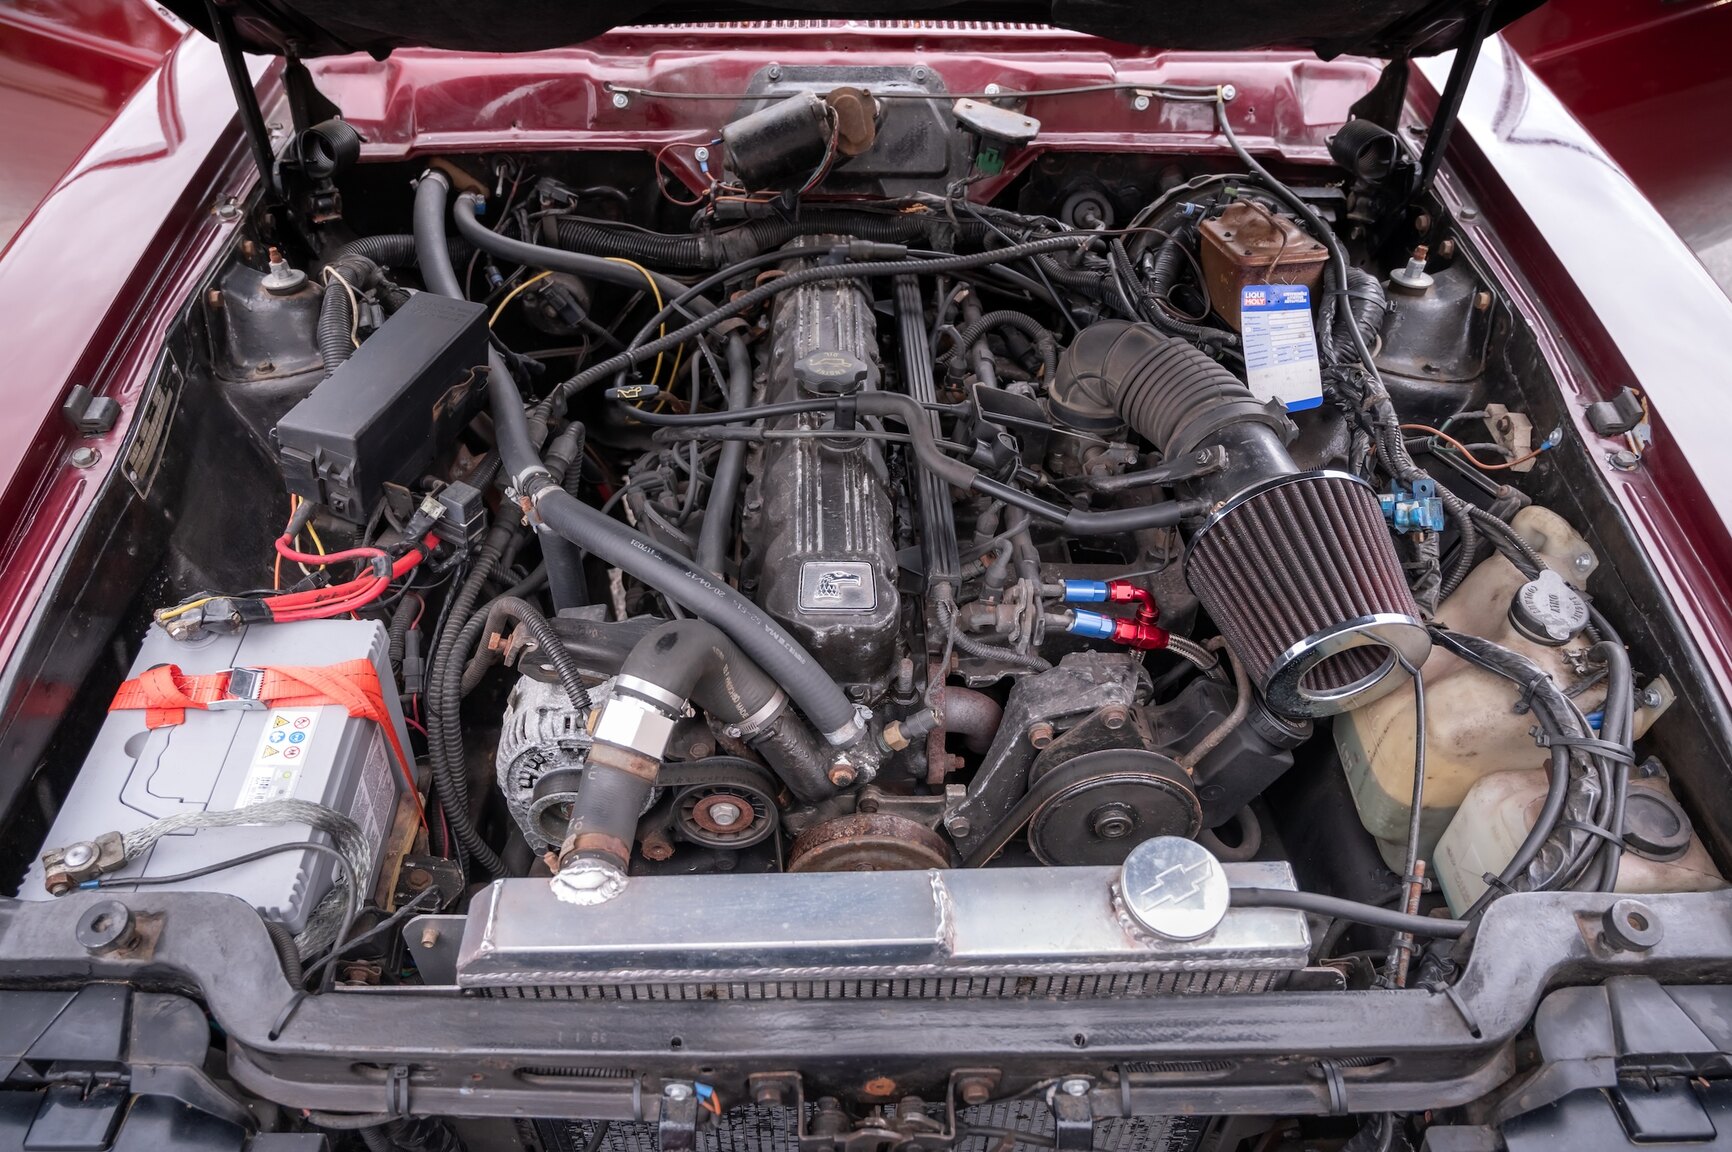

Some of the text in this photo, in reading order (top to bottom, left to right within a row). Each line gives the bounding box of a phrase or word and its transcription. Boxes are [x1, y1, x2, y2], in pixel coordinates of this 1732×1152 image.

[1245, 291, 1265, 299] LIQUI
[685, 571, 726, 598] 20/04/17
[1524, 585, 1542, 614] COOLANT
[1549, 594, 1561, 614] ONLY
